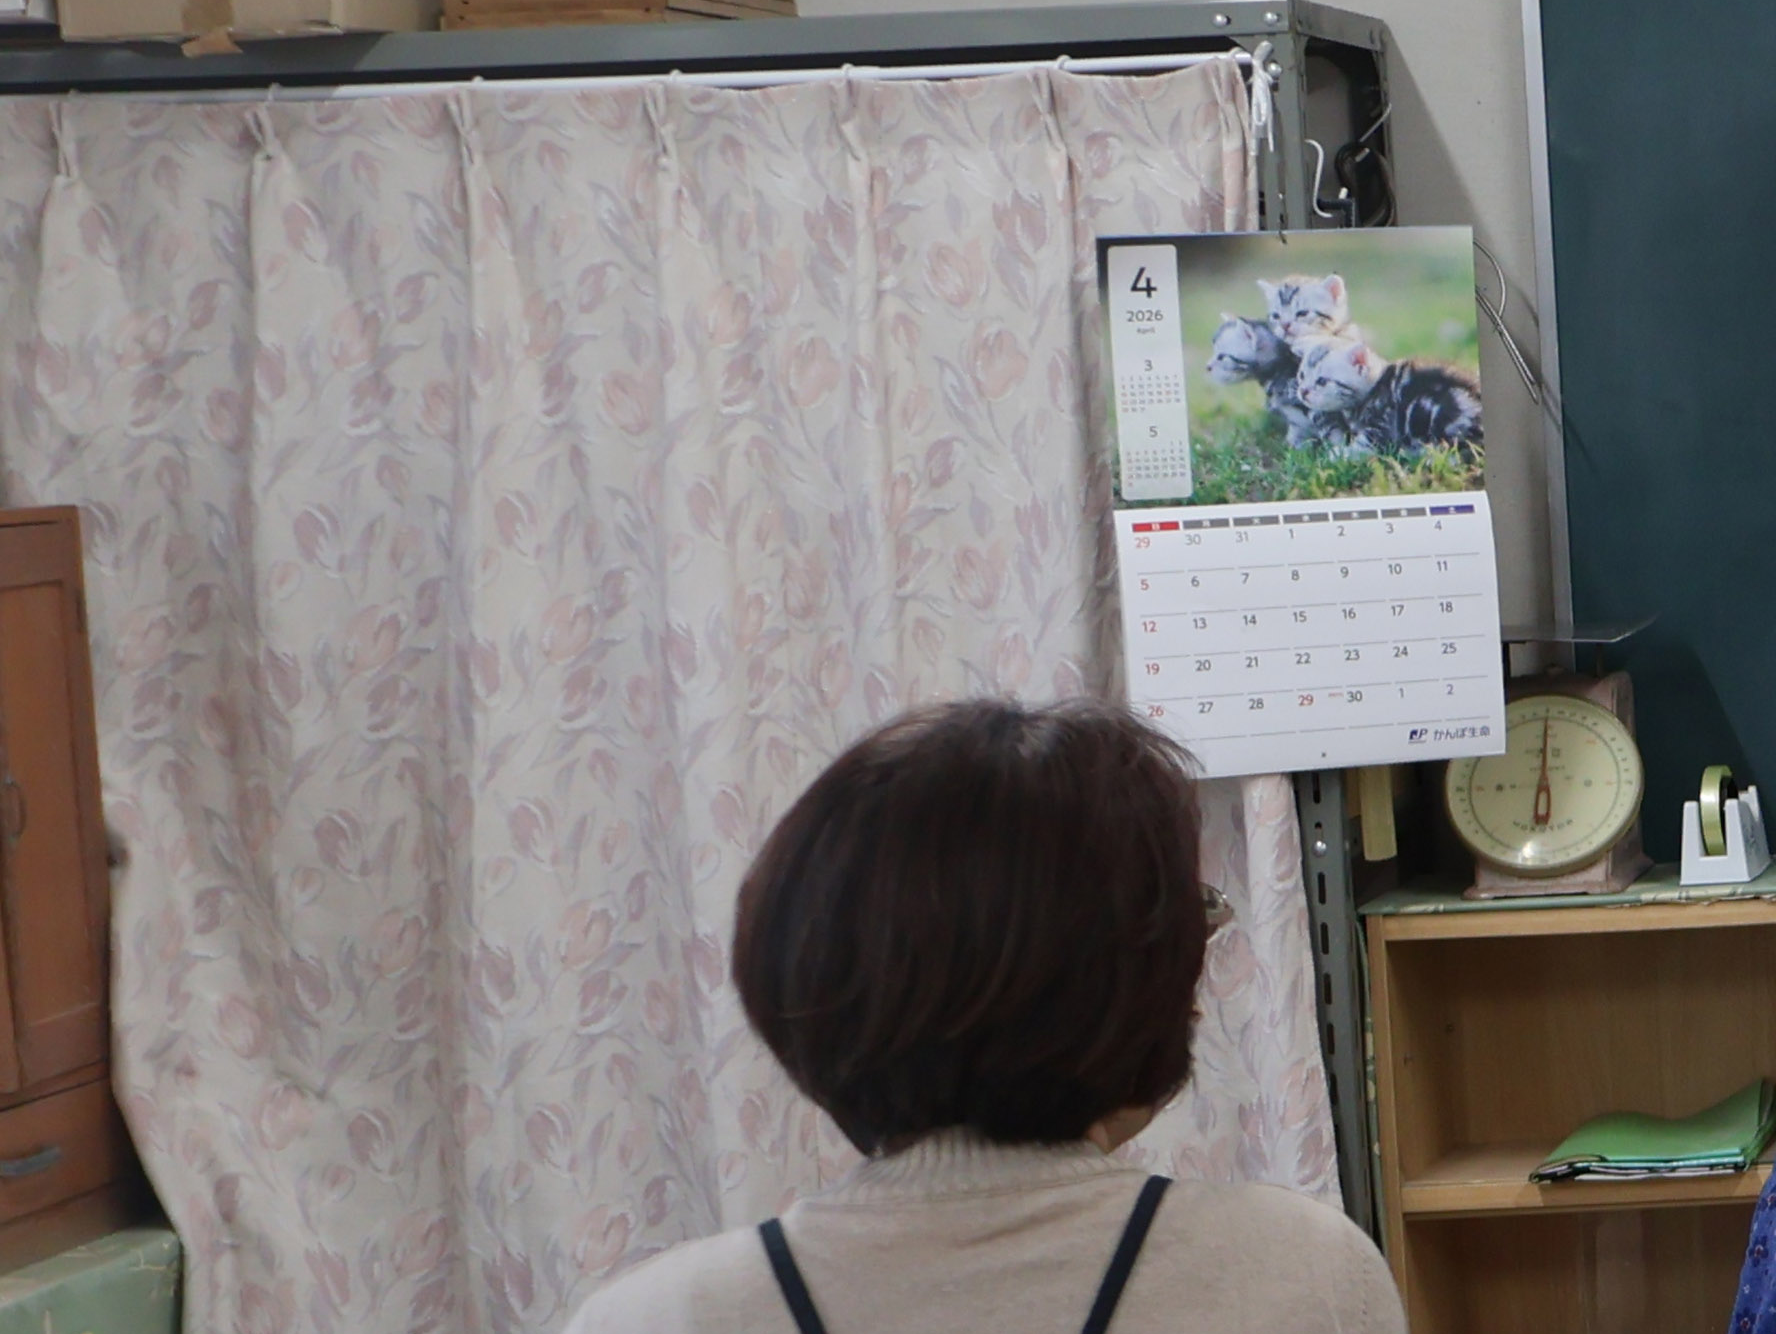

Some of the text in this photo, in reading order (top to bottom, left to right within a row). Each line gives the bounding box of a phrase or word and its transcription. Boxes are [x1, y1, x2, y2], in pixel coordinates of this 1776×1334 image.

[1130, 267, 1157, 298] 4
[1126, 310, 1163, 322] 2026
[1144, 360, 1153, 371] 3
[1150, 426, 1158, 437] 5
[1136, 521, 1442, 548] 29 30 31 1 2 3 4
[1141, 561, 1447, 590] 5 6 7 8 9 10 11
[1143, 602, 1453, 632] 12 13 14 15 16 17 18
[1146, 643, 1456, 675] 19 20 21 22 23 24 25
[1148, 706, 1163, 717] 26
[1199, 702, 1213, 713] 27
[1249, 698, 1264, 710] 28
[1299, 694, 1314, 706] 29
[1347, 691, 1362, 702] 30
[1399, 688, 1404, 698] 1
[1447, 684, 1453, 695] 2
[1434, 726, 1490, 741] かんぽ生命
